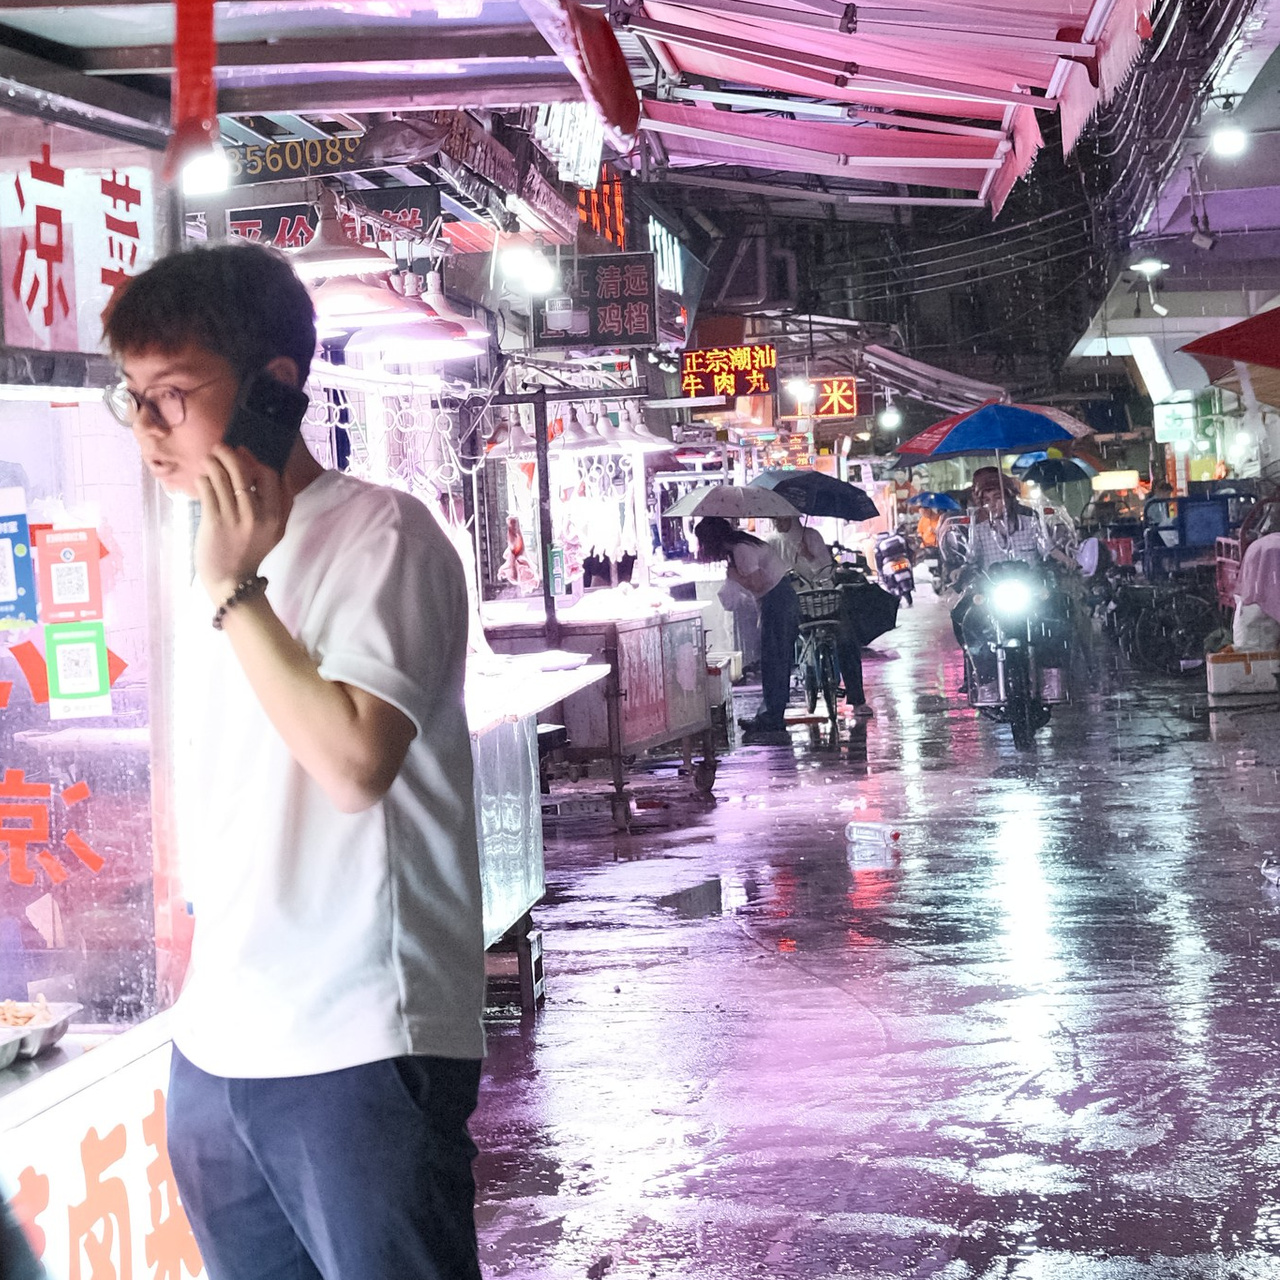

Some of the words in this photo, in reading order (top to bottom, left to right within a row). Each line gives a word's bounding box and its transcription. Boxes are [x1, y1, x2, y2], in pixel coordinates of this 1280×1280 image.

[683, 344, 778, 374] 正宗潮汕
[682, 370, 770, 398] 牛肉丸
